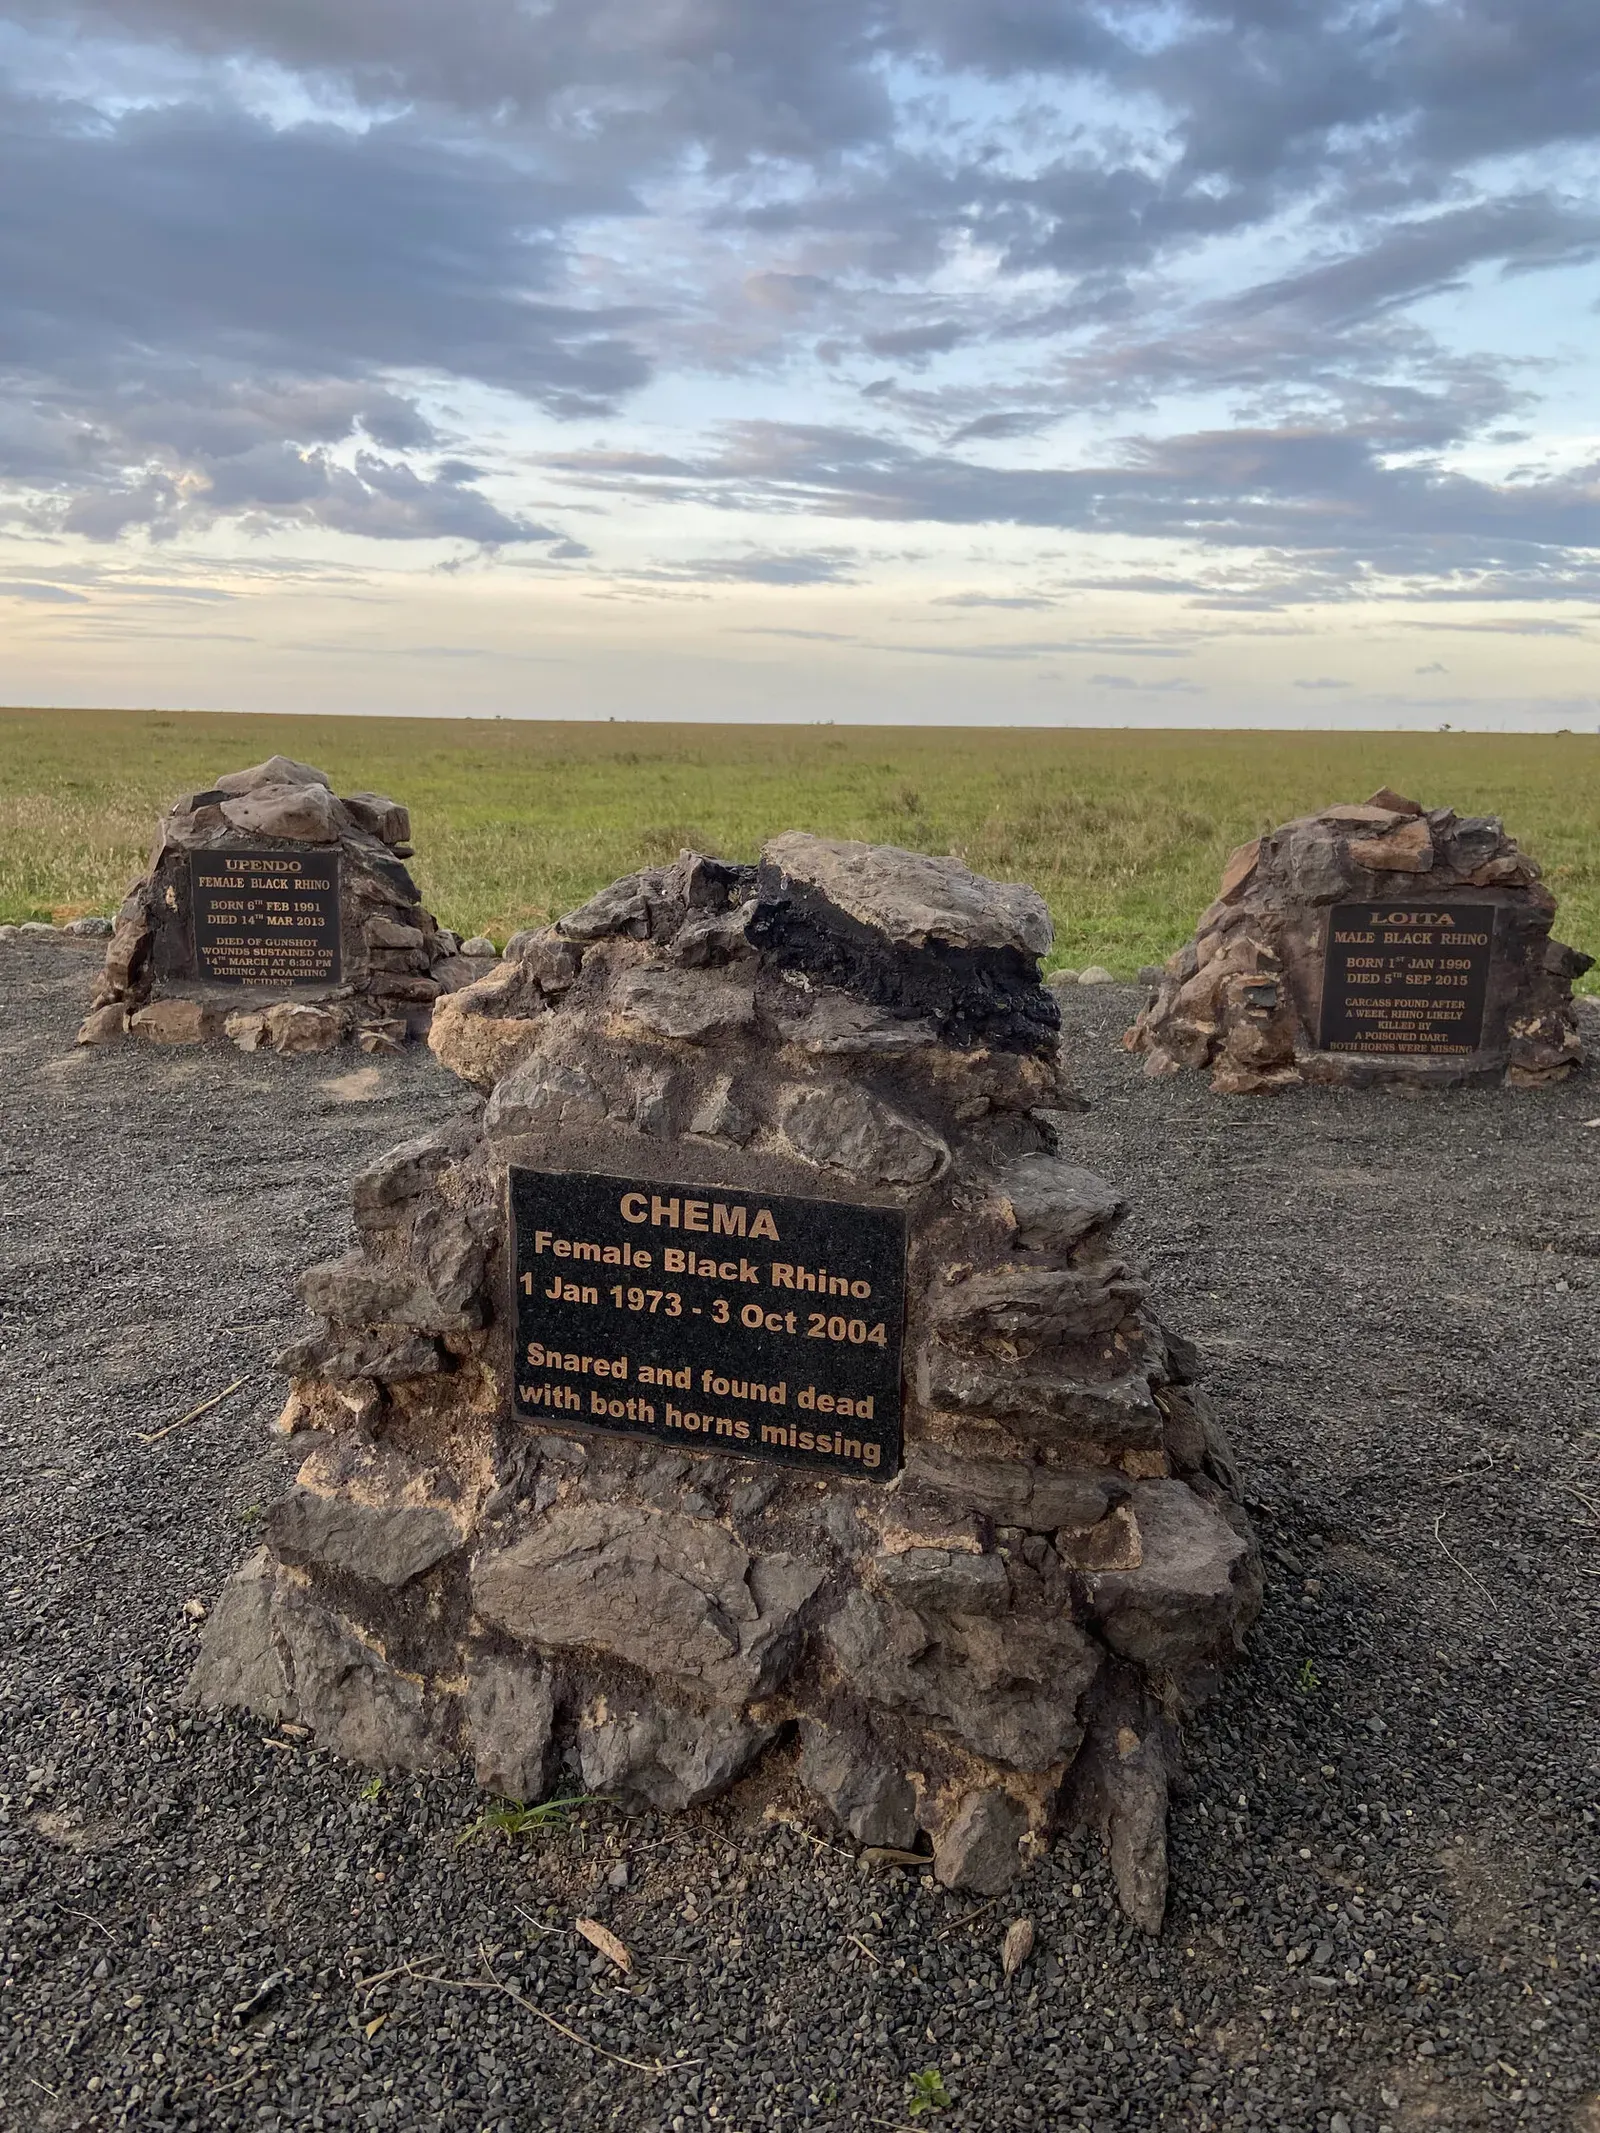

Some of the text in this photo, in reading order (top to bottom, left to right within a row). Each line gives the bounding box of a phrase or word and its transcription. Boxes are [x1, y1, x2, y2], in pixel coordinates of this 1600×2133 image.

[225, 859, 302, 872] UPENDO
[199, 877, 330, 890] FEMALE BLACK RHINO
[210, 900, 243, 910] BORN
[266, 902, 289, 911] FEB
[294, 902, 321, 912] 1991
[207, 915, 237, 924] DIED
[267, 916, 293, 926] MAR
[297, 917, 325, 927] 2013
[1370, 912, 1455, 924] LOITA
[216, 937, 243, 945] DIED
[265, 939, 318, 947] GUNSHOT
[1335, 932, 1488, 945] MALE BLACK RHINO
[201, 947, 250, 955] WOUNDS
[253, 948, 314, 956] SUSTAINED
[229, 957, 268, 966] MARCH
[272, 958, 286, 966] AT
[316, 959, 331, 967] PM
[1346, 958, 1383, 968] BORN
[1408, 959, 1434, 969] JAN
[1440, 959, 1471, 969] 1990
[271, 969, 327, 977] POACHING
[242, 978, 294, 986] INCIDENT
[1346, 973, 1380, 984] DIED
[1405, 975, 1431, 985] SEP
[1436, 975, 1468, 986] 2015
[1345, 998, 1465, 1009] CARCASS FOUND AFTER
[1391, 1011, 1424, 1019] RHINO
[1427, 1012, 1463, 1020] LIKELY
[1378, 1021, 1432, 1030] KILLED BY
[1365, 1032, 1416, 1041] POISONED
[1330, 1042, 1472, 1053] BOTH HORNS WERE MISSING
[619, 1192, 781, 1241] CHEMA
[533, 1230, 872, 1299] Female Black Rhino
[519, 1272, 533, 1295] 1
[545, 1276, 598, 1304] Jan
[610, 1285, 682, 1317] 1973
[712, 1300, 729, 1323] 3
[741, 1304, 797, 1334] Oct
[807, 1313, 888, 1347] 2004
[527, 1342, 874, 1419] Snared and found dead
[518, 1383, 881, 1468] with both horns missing
